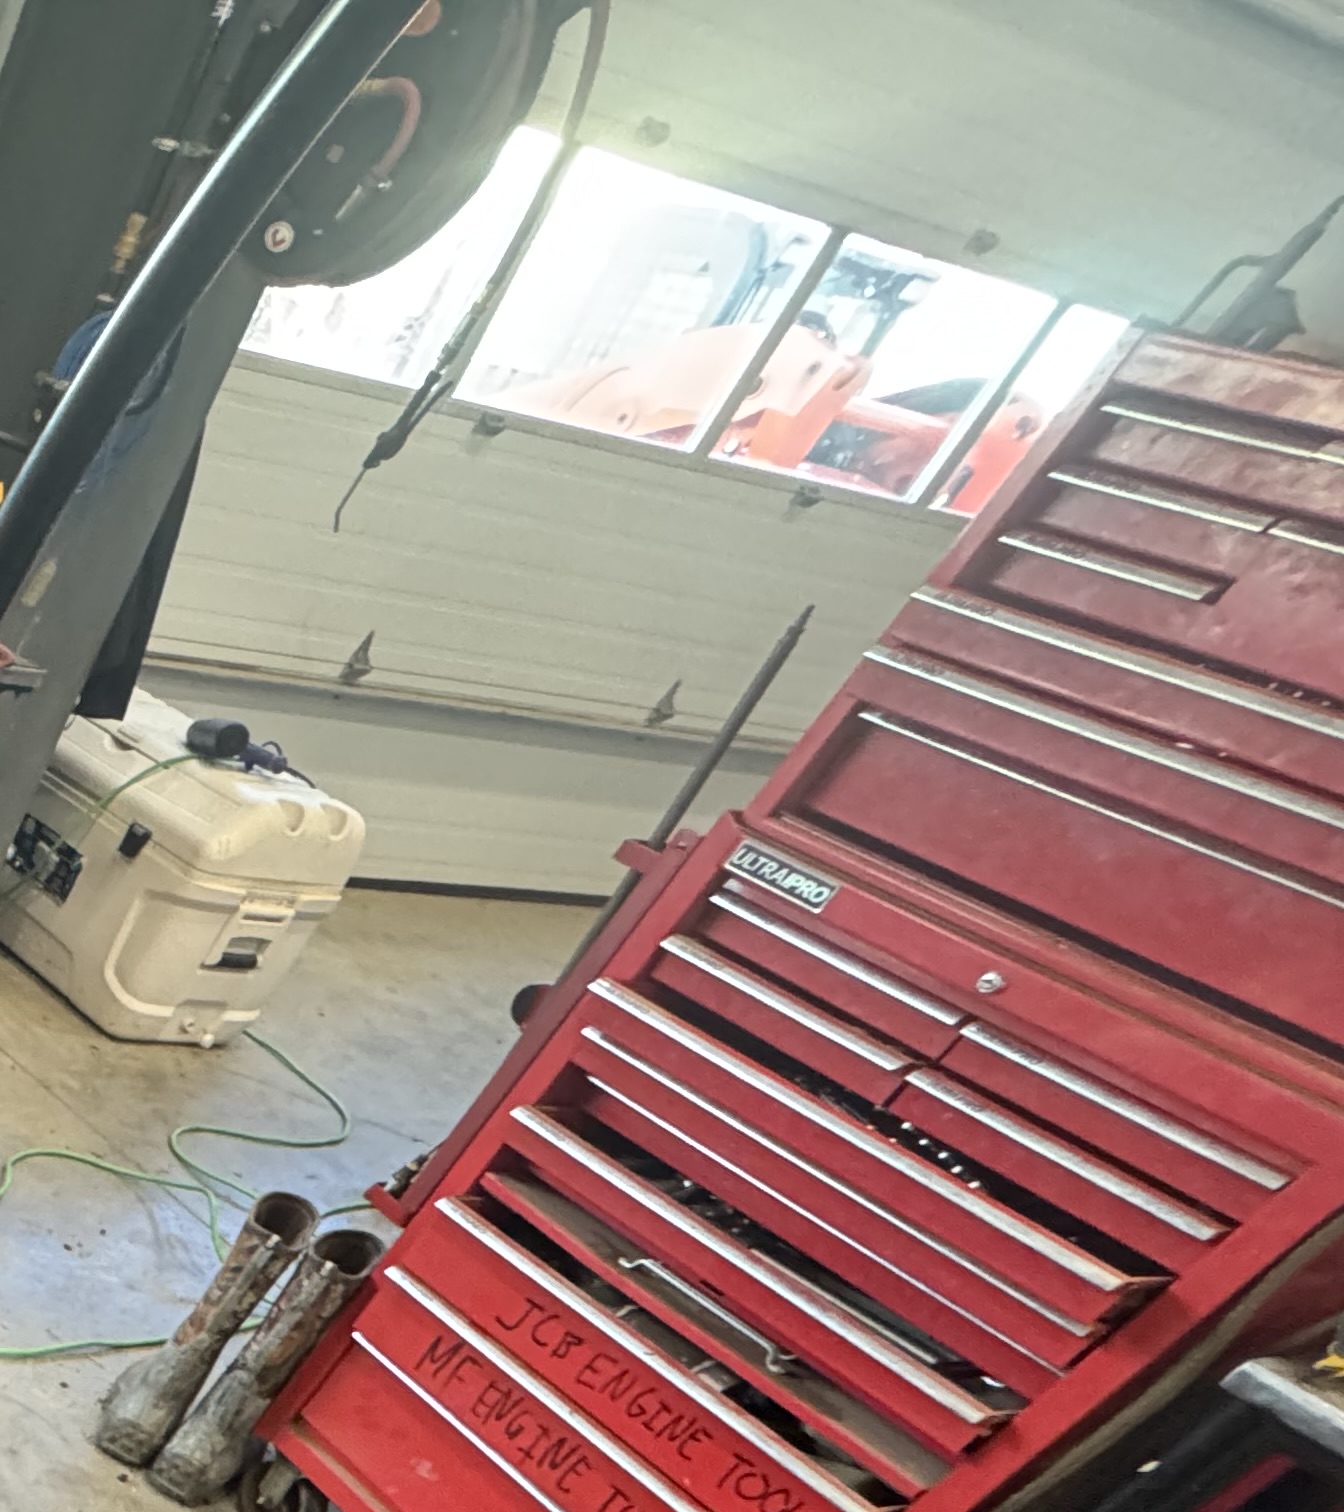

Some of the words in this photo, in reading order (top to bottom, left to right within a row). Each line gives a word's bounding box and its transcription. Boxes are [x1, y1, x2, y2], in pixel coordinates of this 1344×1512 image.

[414, 1335, 483, 1386] MF
[472, 1380, 595, 1496] ENGINE
[496, 1298, 584, 1360] JCB
[576, 1353, 715, 1461] ENGINE
